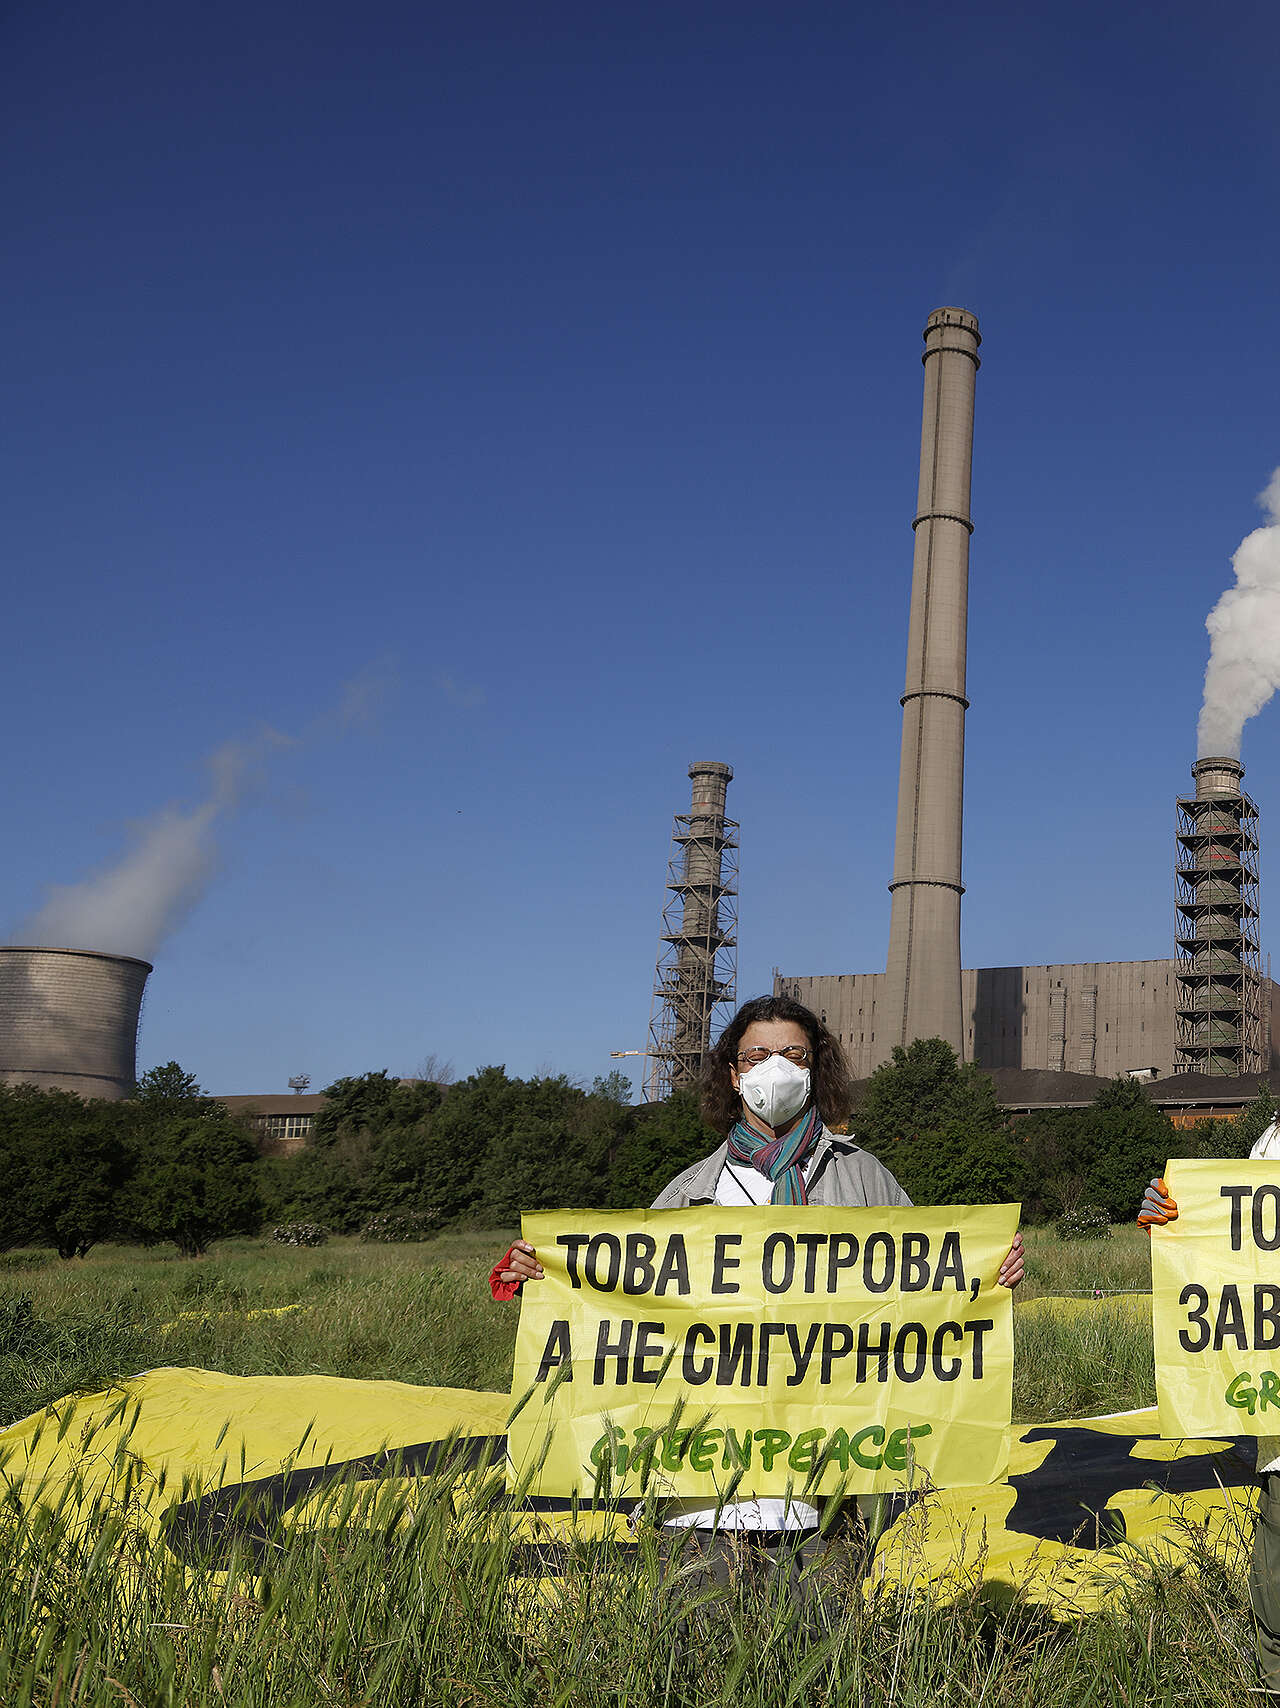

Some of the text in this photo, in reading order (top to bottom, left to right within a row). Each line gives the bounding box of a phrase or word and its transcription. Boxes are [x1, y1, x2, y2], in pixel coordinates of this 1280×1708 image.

[557, 1232, 981, 1302] ТОВА Е ОТРОВА,
[535, 1319, 994, 1388] А НЕ СИГУРНОСТ
[590, 1423, 933, 1476] GREENPEACE
